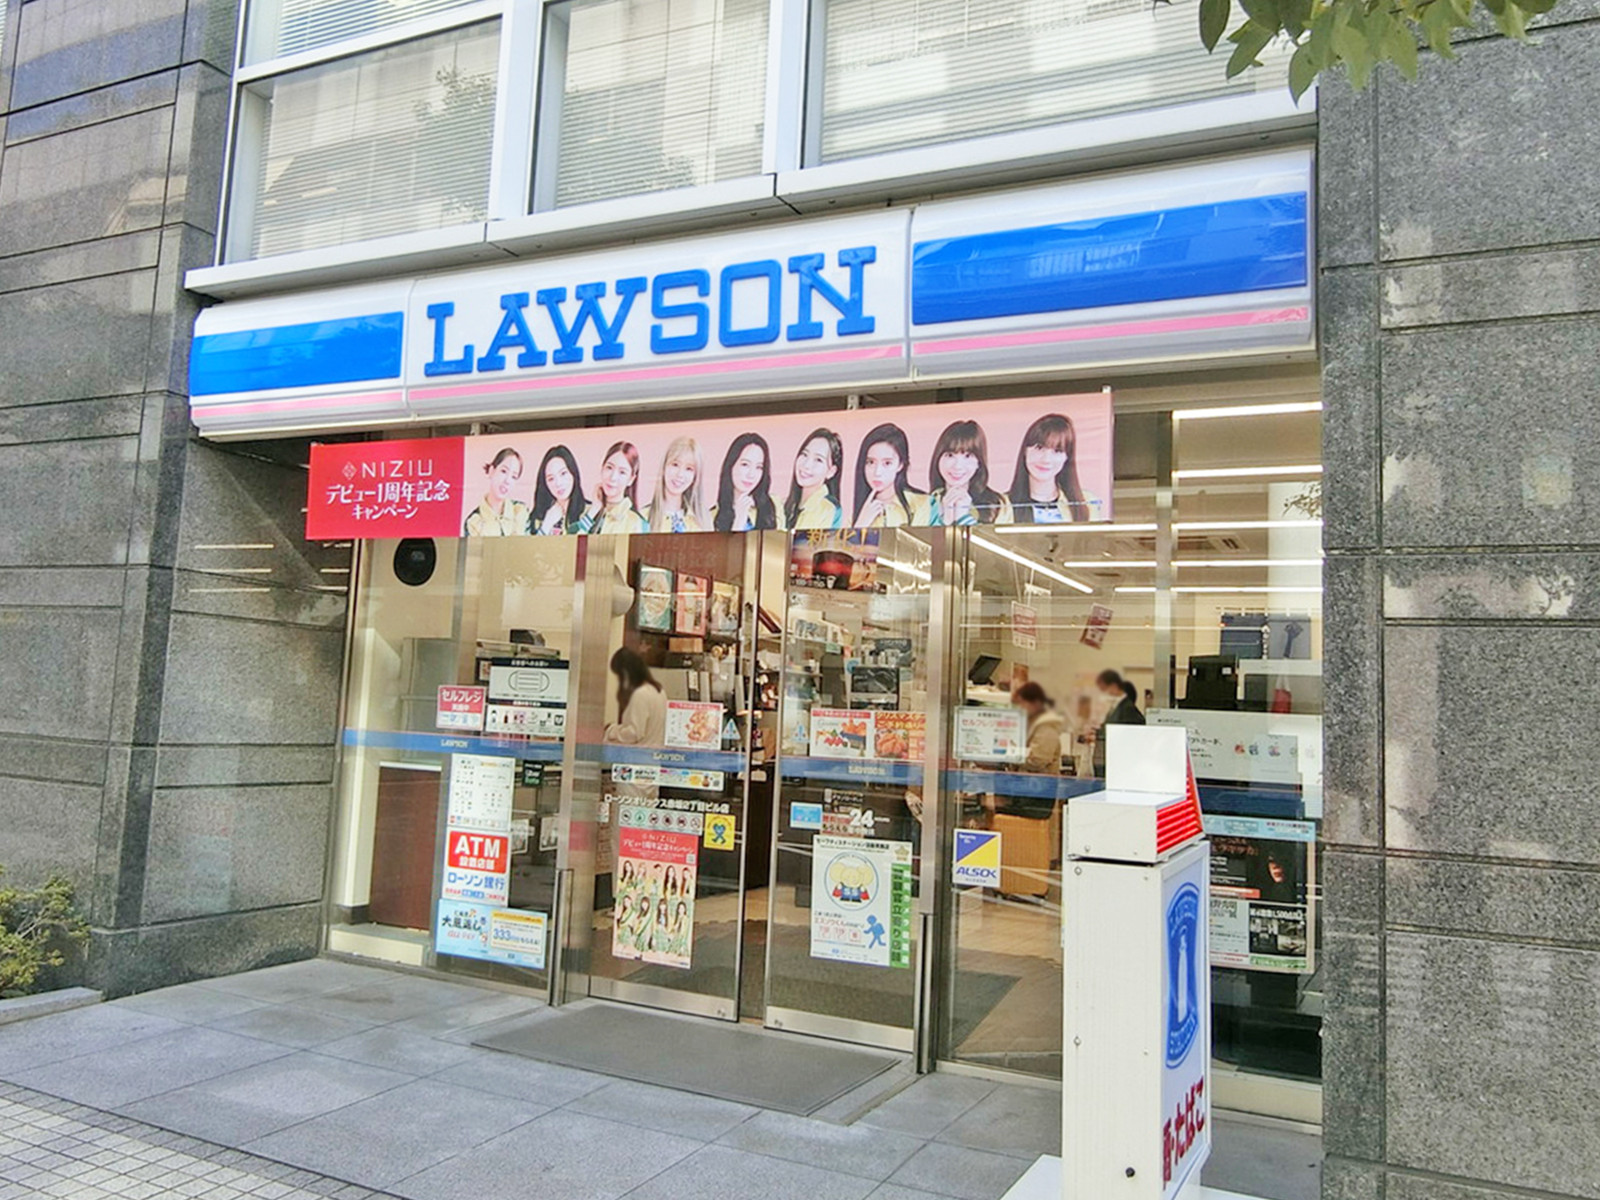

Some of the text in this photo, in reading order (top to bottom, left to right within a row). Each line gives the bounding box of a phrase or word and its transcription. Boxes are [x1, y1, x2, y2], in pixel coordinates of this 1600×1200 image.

[424, 245, 876, 377] LAWSON
[326, 479, 450, 504] デビュー1周年記念
[352, 503, 418, 520] キャンペーン
[441, 689, 483, 703] セルフレジ
[849, 810, 875, 828] 24
[454, 834, 501, 858] ATM
[447, 871, 505, 891] ローソン銀行
[956, 866, 997, 879] ALSOK
